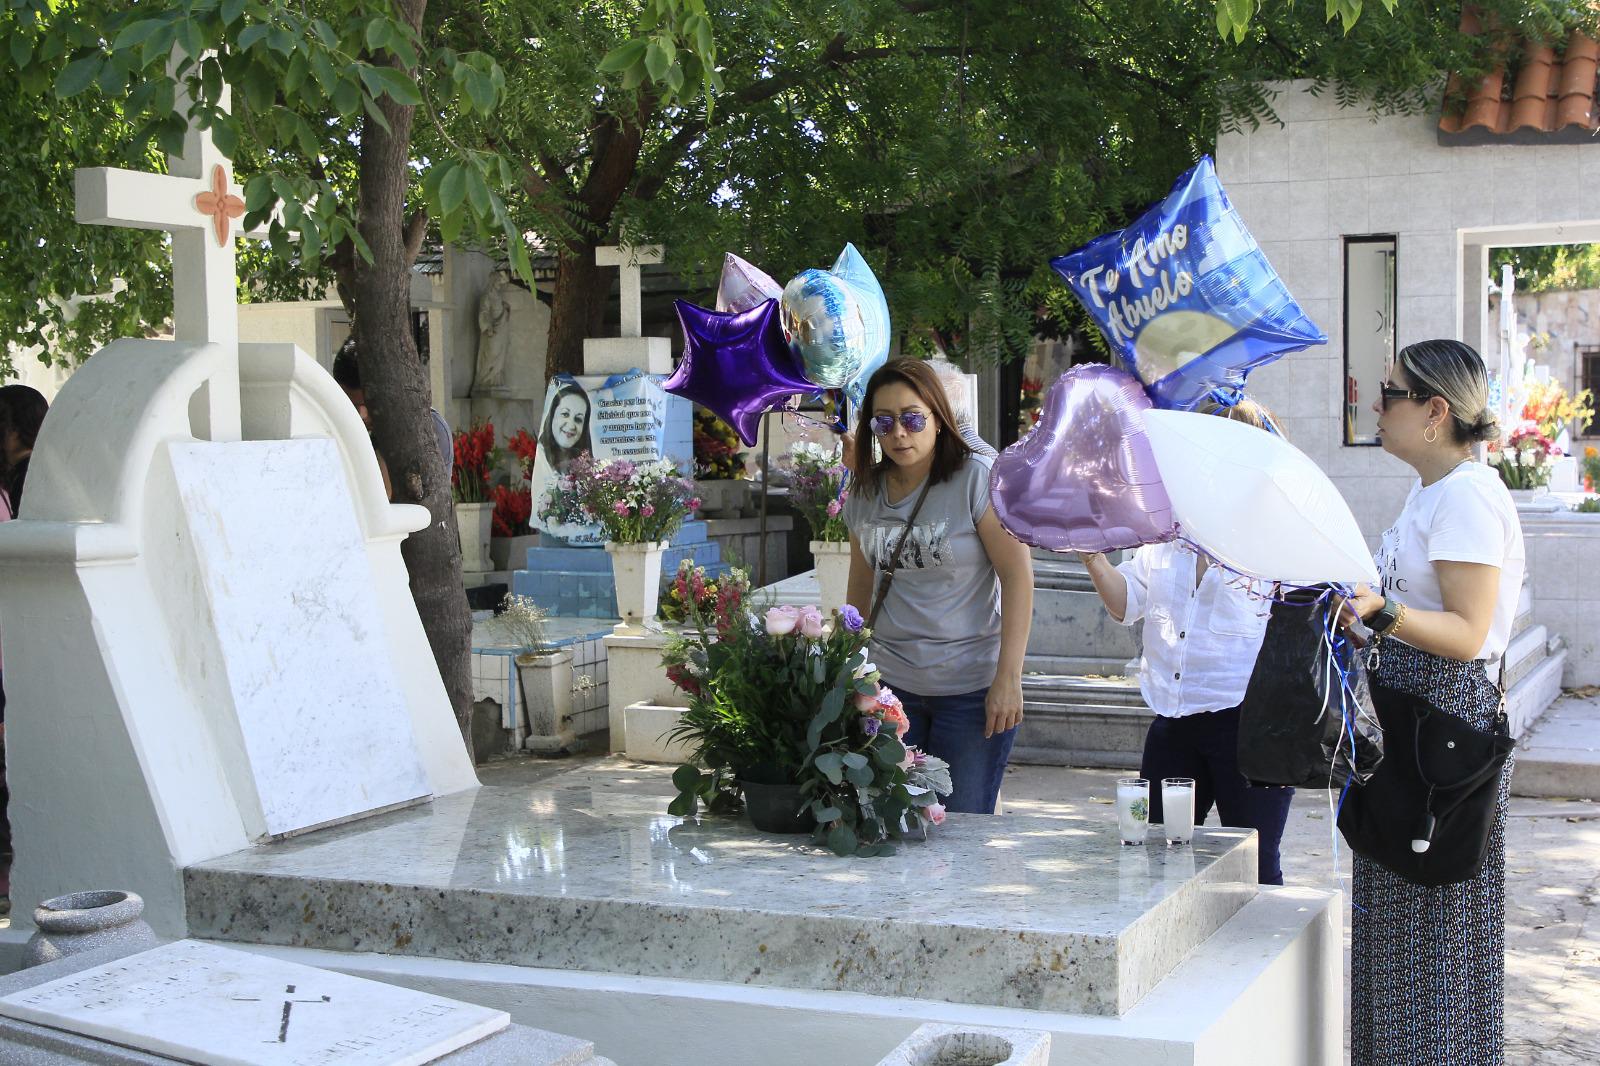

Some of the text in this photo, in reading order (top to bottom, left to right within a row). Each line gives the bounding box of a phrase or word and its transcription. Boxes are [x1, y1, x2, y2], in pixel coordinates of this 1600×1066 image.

[1080, 223, 1188, 308] Te Amo
[1107, 269, 1193, 347] Abuelo
